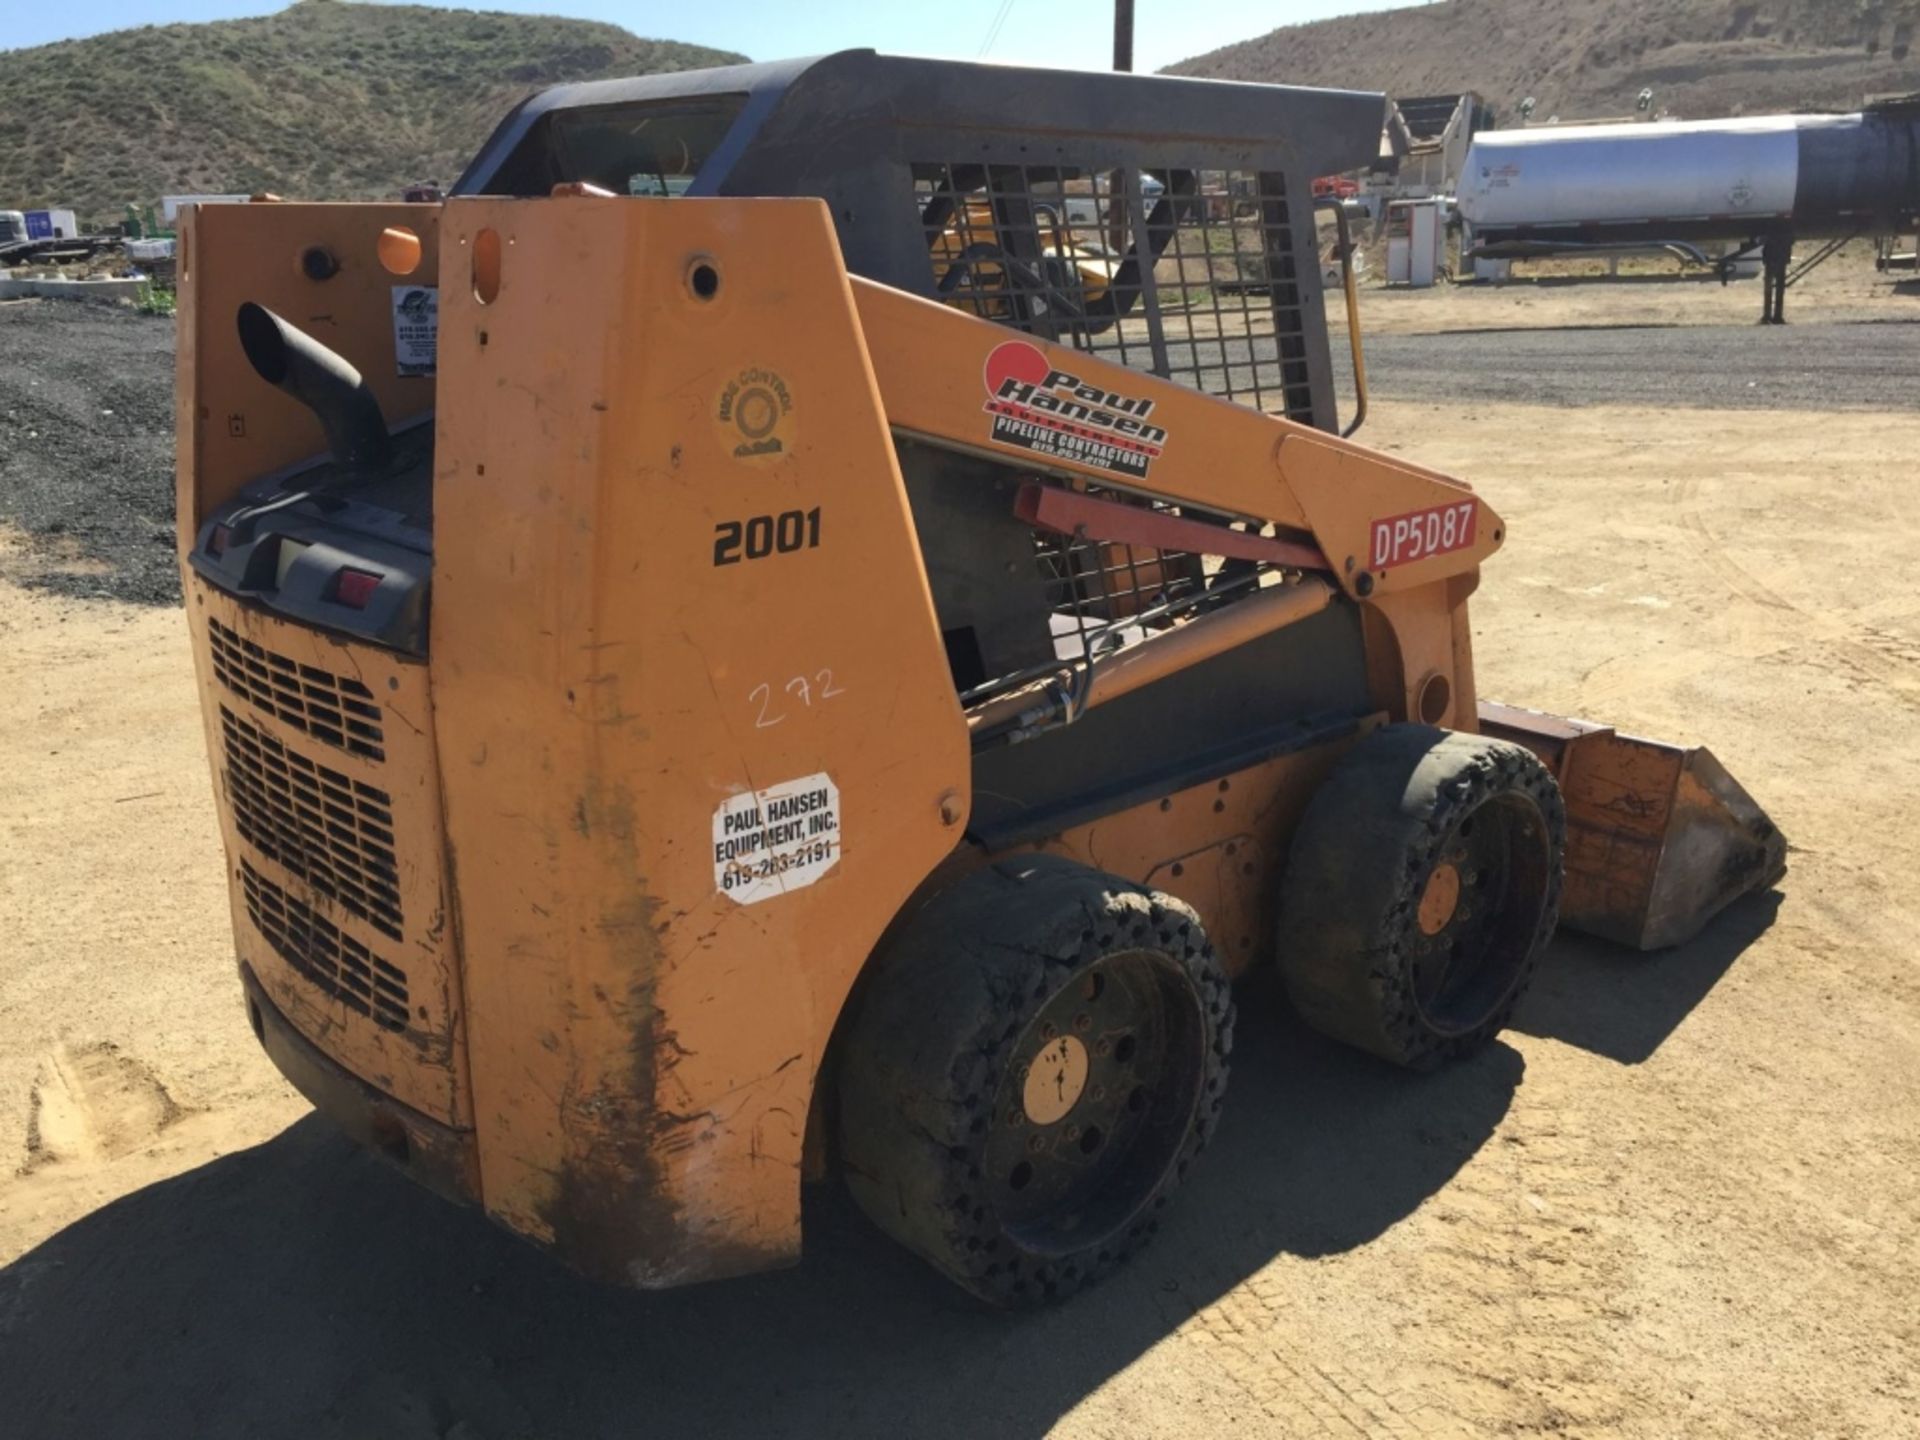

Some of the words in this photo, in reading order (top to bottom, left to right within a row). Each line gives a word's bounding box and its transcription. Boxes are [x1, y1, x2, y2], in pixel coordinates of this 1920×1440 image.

[998, 377, 1167, 443] Hansen
[1042, 370, 1154, 417] Paul
[997, 419, 1055, 443] PIPELINE
[1058, 434, 1146, 468] CONTRACTORS
[714, 506, 821, 566] 2001
[1376, 504, 1472, 565] DP5D87
[748, 669, 846, 728] 272
[716, 819, 805, 862] EQUIPMENT,
[809, 811, 837, 835] INC.
[724, 806, 763, 835] PAUL
[768, 788, 828, 823] HANSEN
